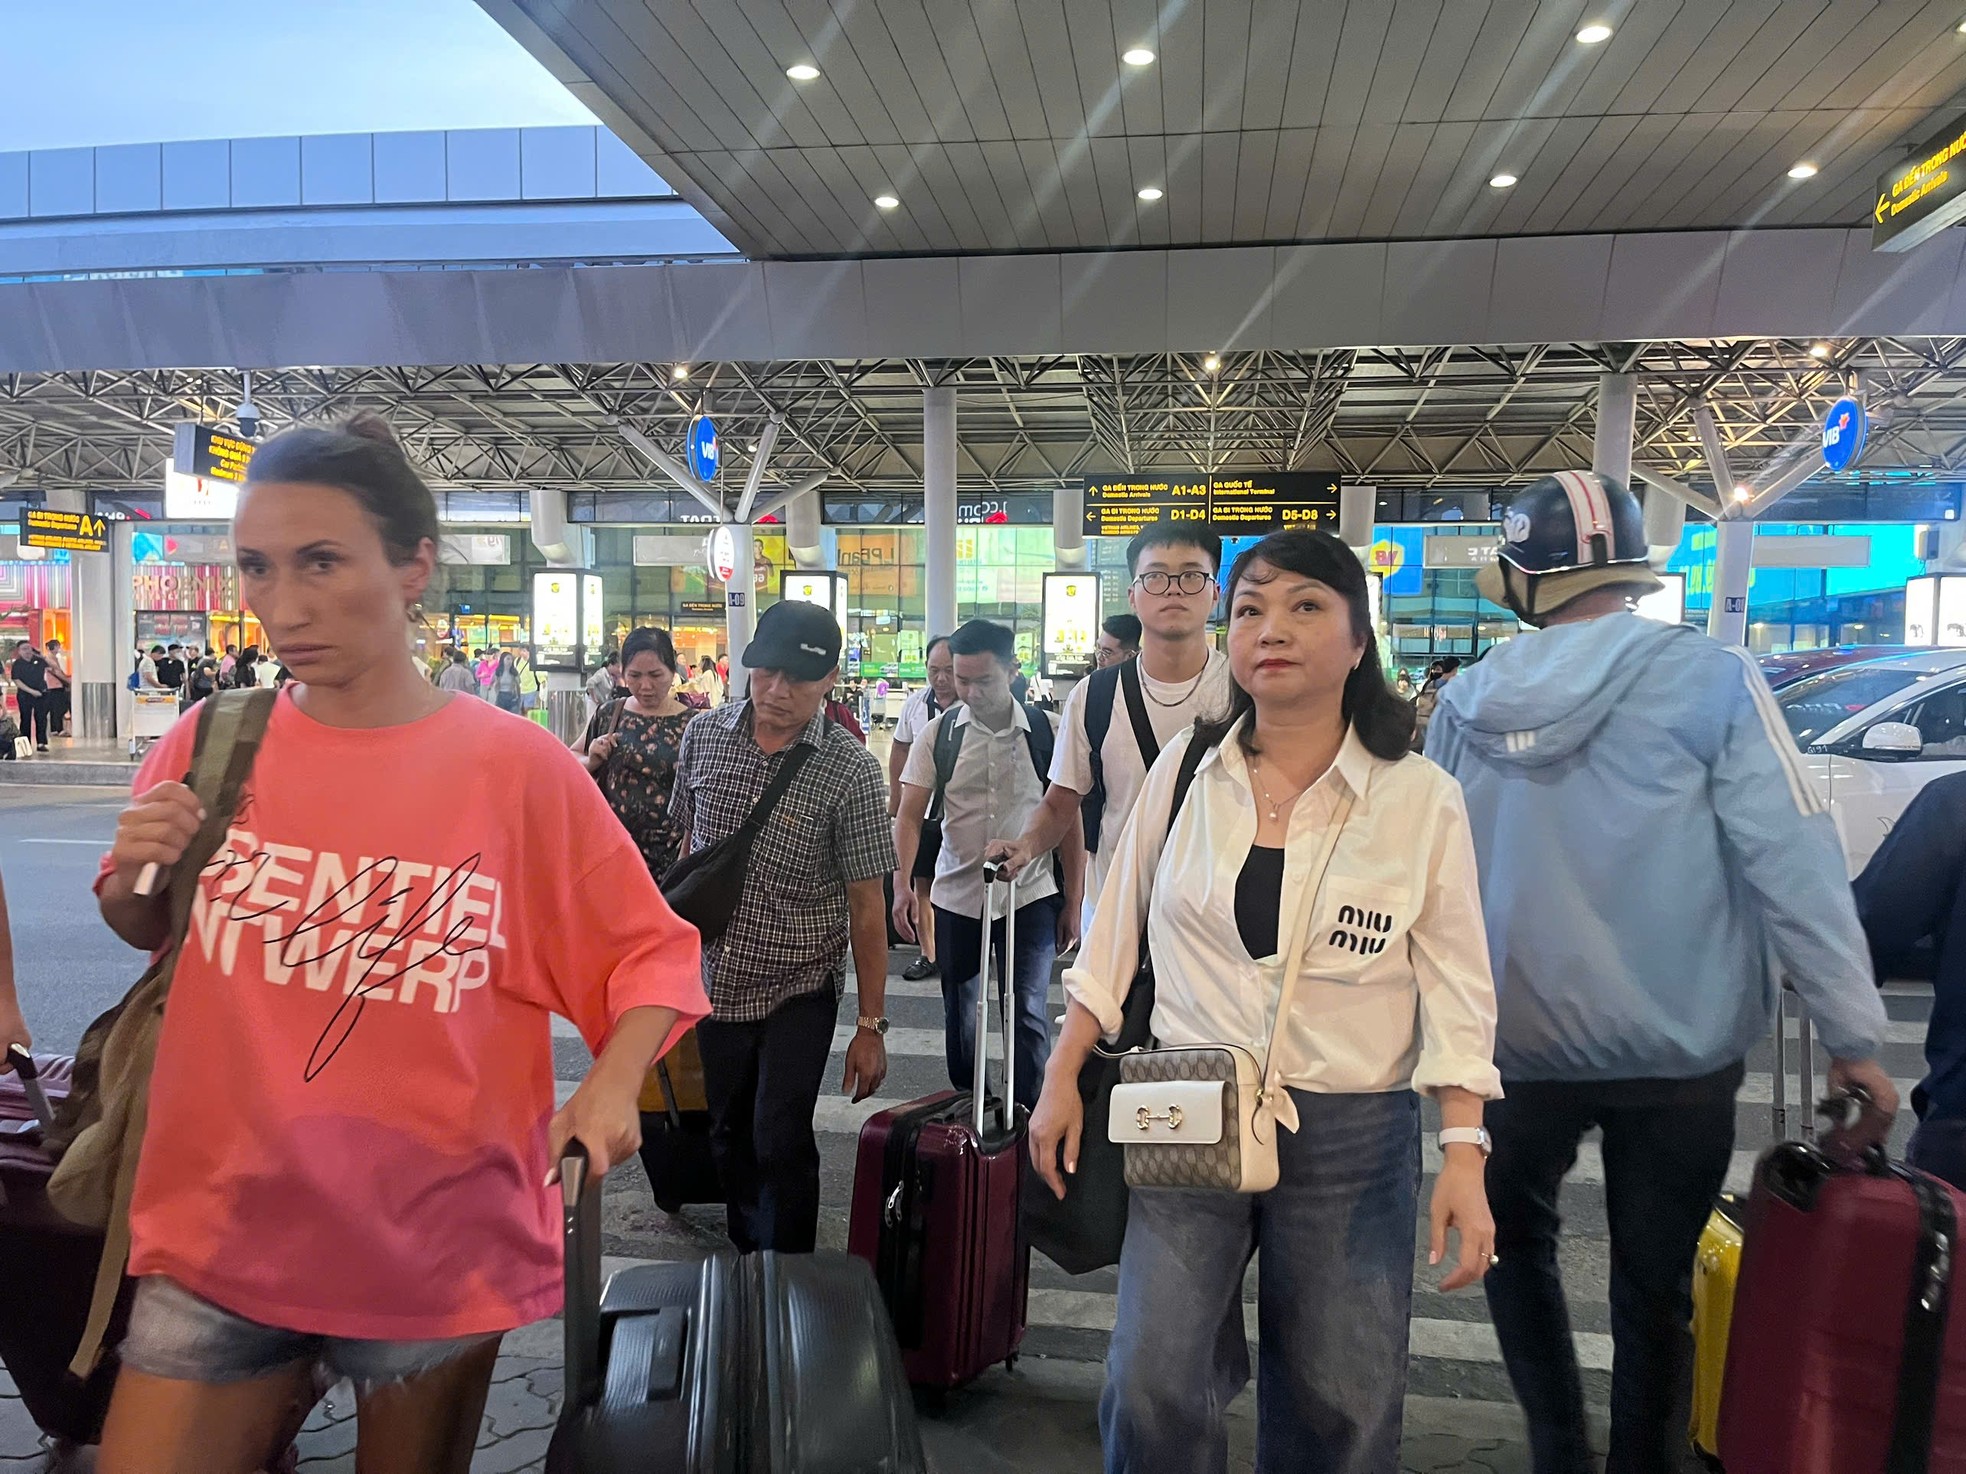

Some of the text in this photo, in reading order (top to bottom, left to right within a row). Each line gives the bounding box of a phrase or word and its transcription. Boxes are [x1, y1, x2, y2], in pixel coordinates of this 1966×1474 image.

[1892, 180, 1904, 197] GA
[1920, 147, 1949, 178] TRONG
[1822, 426, 1840, 448] VIB
[701, 440, 715, 460] VIB
[1171, 484, 1207, 496] A1-A3
[1213, 481, 1223, 489] GA
[1101, 507, 1110, 515] GA
[1119, 507, 1140, 515] TRONG
[1170, 508, 1206, 521] D1-D4
[1212, 506, 1222, 514] GA
[1231, 506, 1254, 514] TRONG
[1127, 515, 1159, 523] Departures
[1240, 514, 1272, 522] Departures
[79, 514, 94, 537] A
[132, 575, 235, 592] PHOENIX
